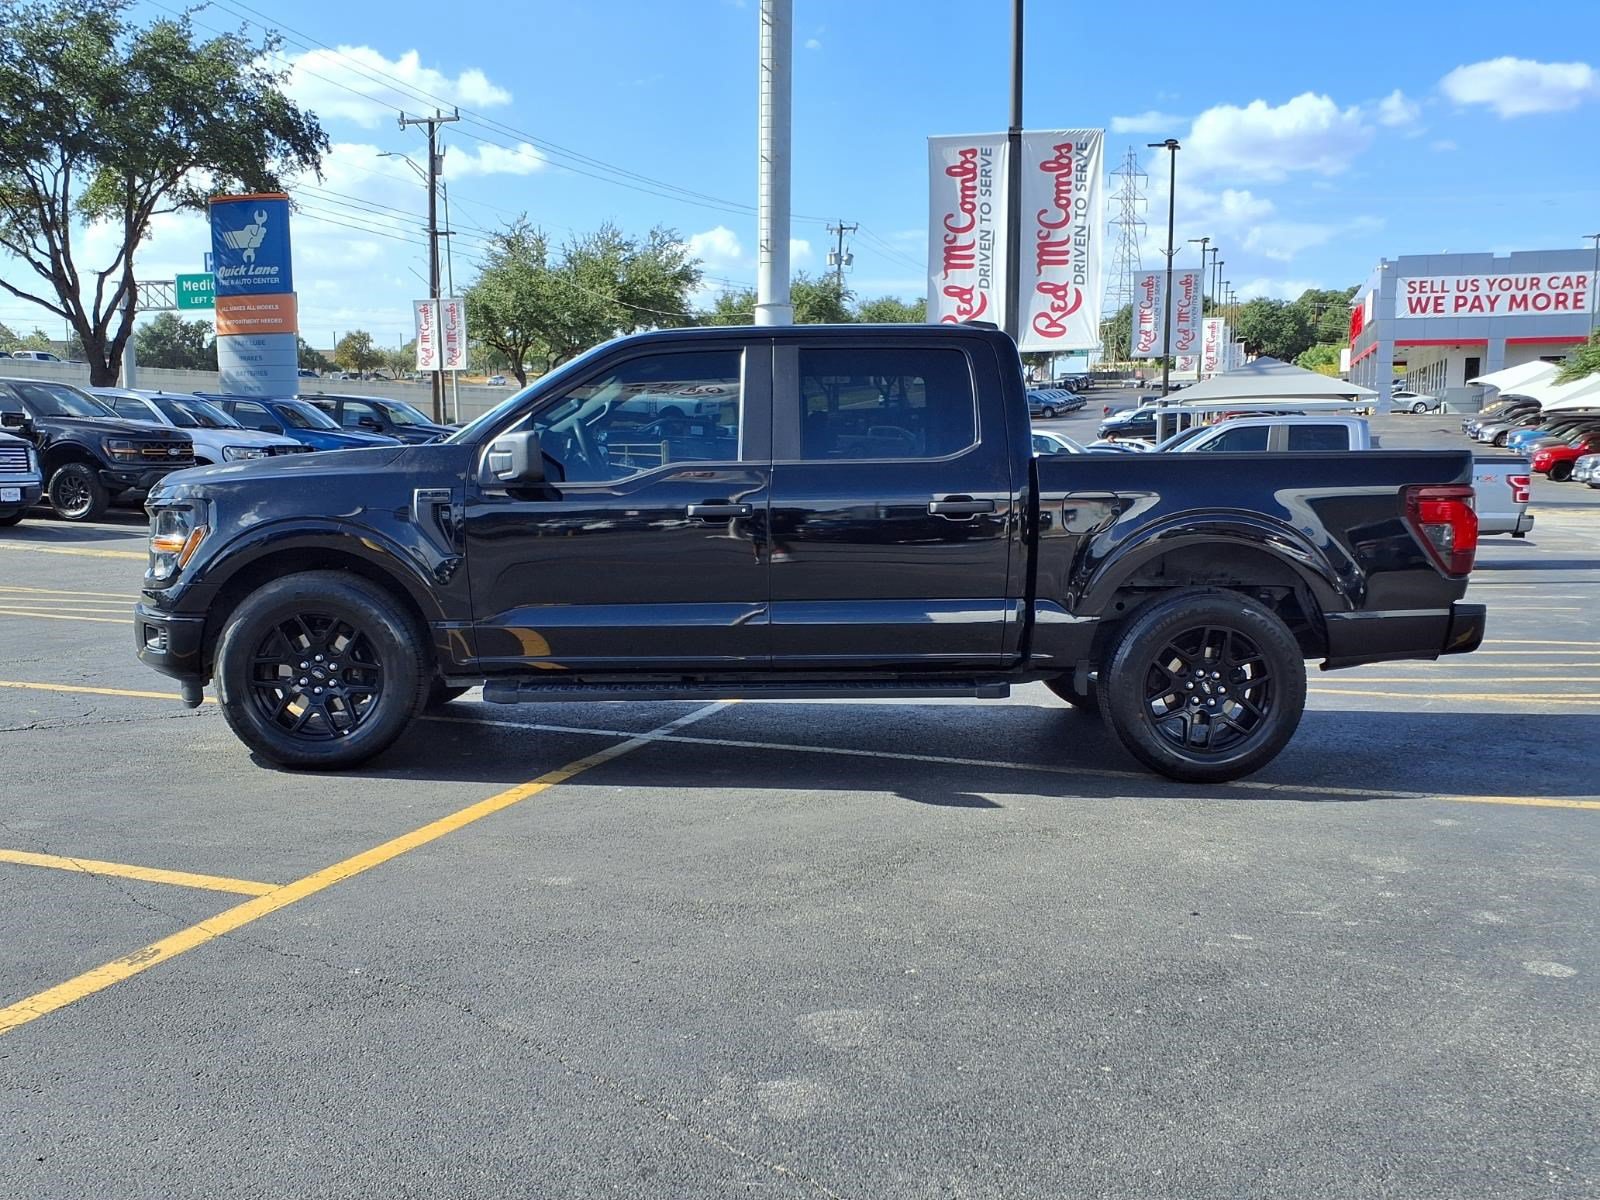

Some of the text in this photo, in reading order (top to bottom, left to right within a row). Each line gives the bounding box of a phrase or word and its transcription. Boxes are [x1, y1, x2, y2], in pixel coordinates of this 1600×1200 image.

[942, 148, 978, 281] McCombs
[979, 147, 993, 289] DRIVEN TO SERVE
[1033, 142, 1082, 339] Red McCombs
[1073, 142, 1088, 285] DRIVEN TO SERVE
[219, 264, 279, 277] Quick Lane
[1154, 297, 1160, 306] TO
[1407, 275, 1587, 294] SELL US YOUR CAR
[419, 303, 434, 366] Red McCombs
[445, 303, 461, 366] Red McCombs
[1136, 275, 1157, 352] Red McCombs
[1175, 274, 1195, 351] Red McCombs
[1407, 292, 1586, 314] WE PAY MORE
[1204, 356, 1218, 371] Red
